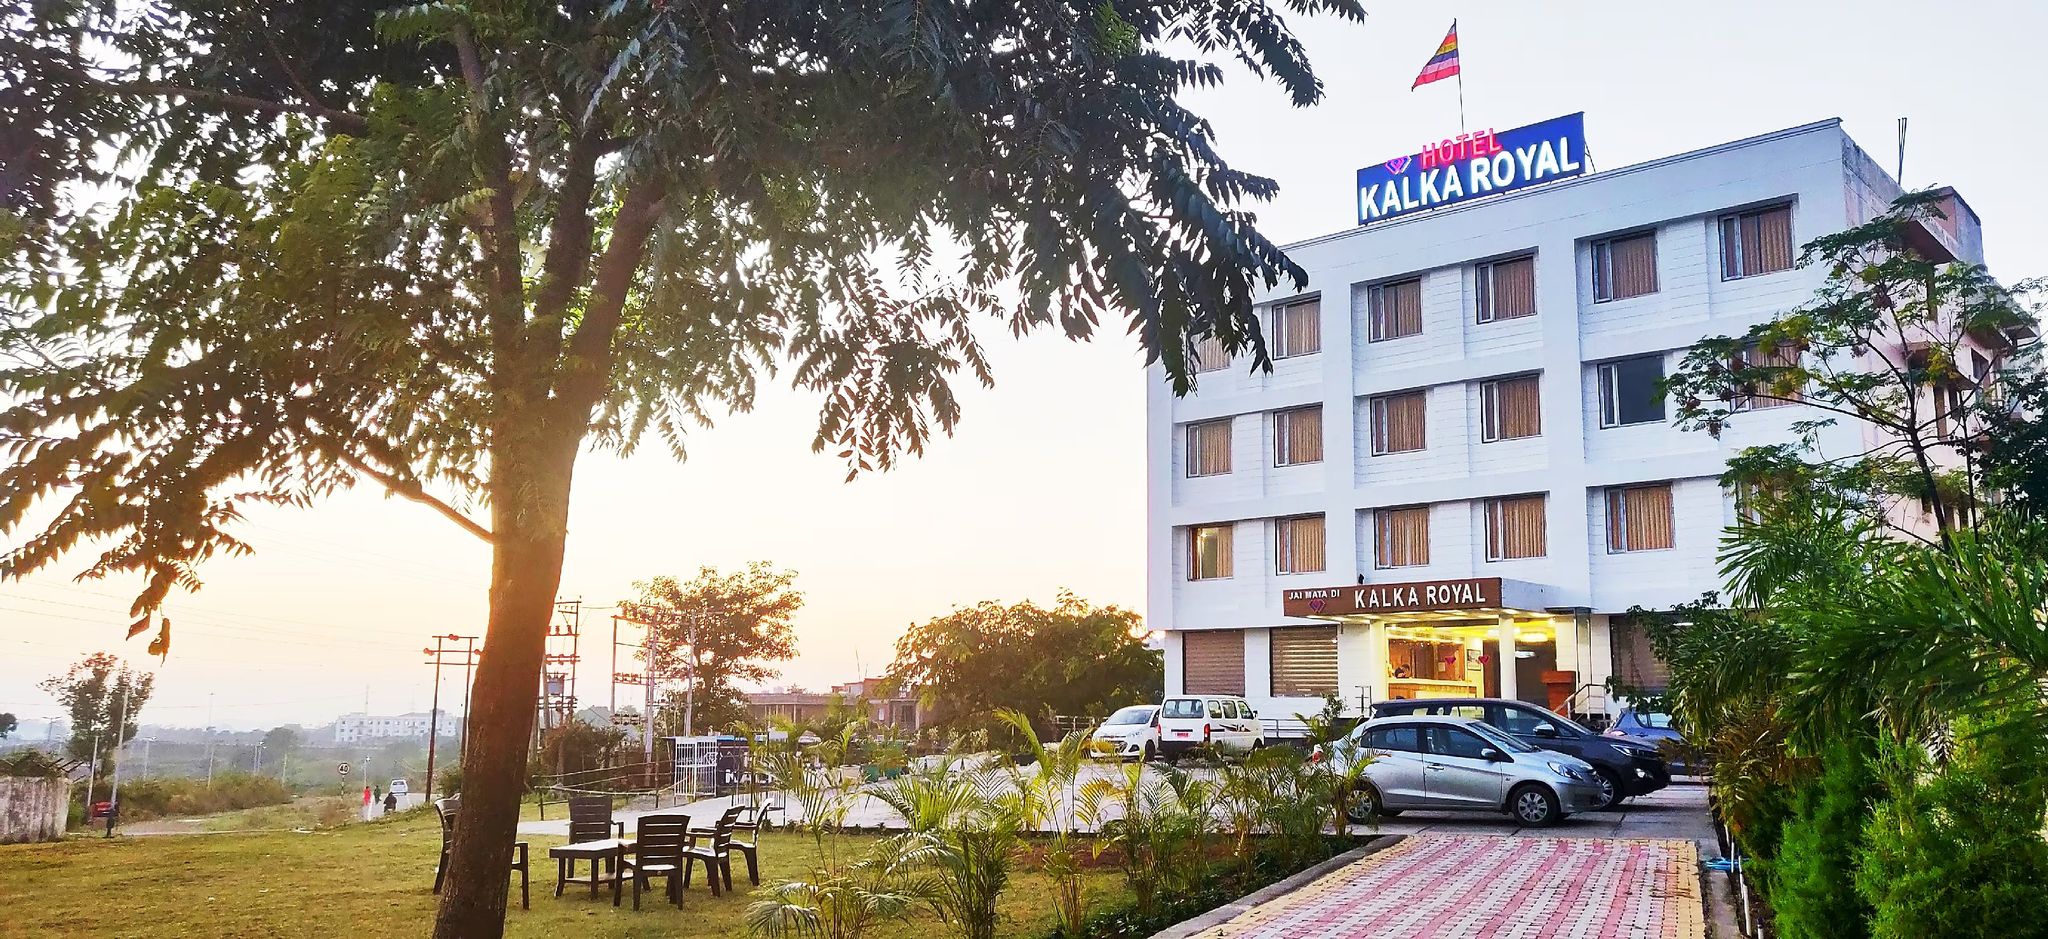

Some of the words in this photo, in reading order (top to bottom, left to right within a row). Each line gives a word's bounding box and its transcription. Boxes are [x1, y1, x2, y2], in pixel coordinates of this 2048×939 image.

[1421, 128, 1502, 170] HOTEL
[1359, 164, 1464, 220] KALKA
[1470, 136, 1580, 194] ROYAL
[1288, 591, 1303, 600] JAI
[1305, 590, 1328, 599] MATA
[1330, 589, 1340, 598] DI
[1354, 586, 1420, 609] KALKA
[1426, 582, 1486, 606] ROYAL
